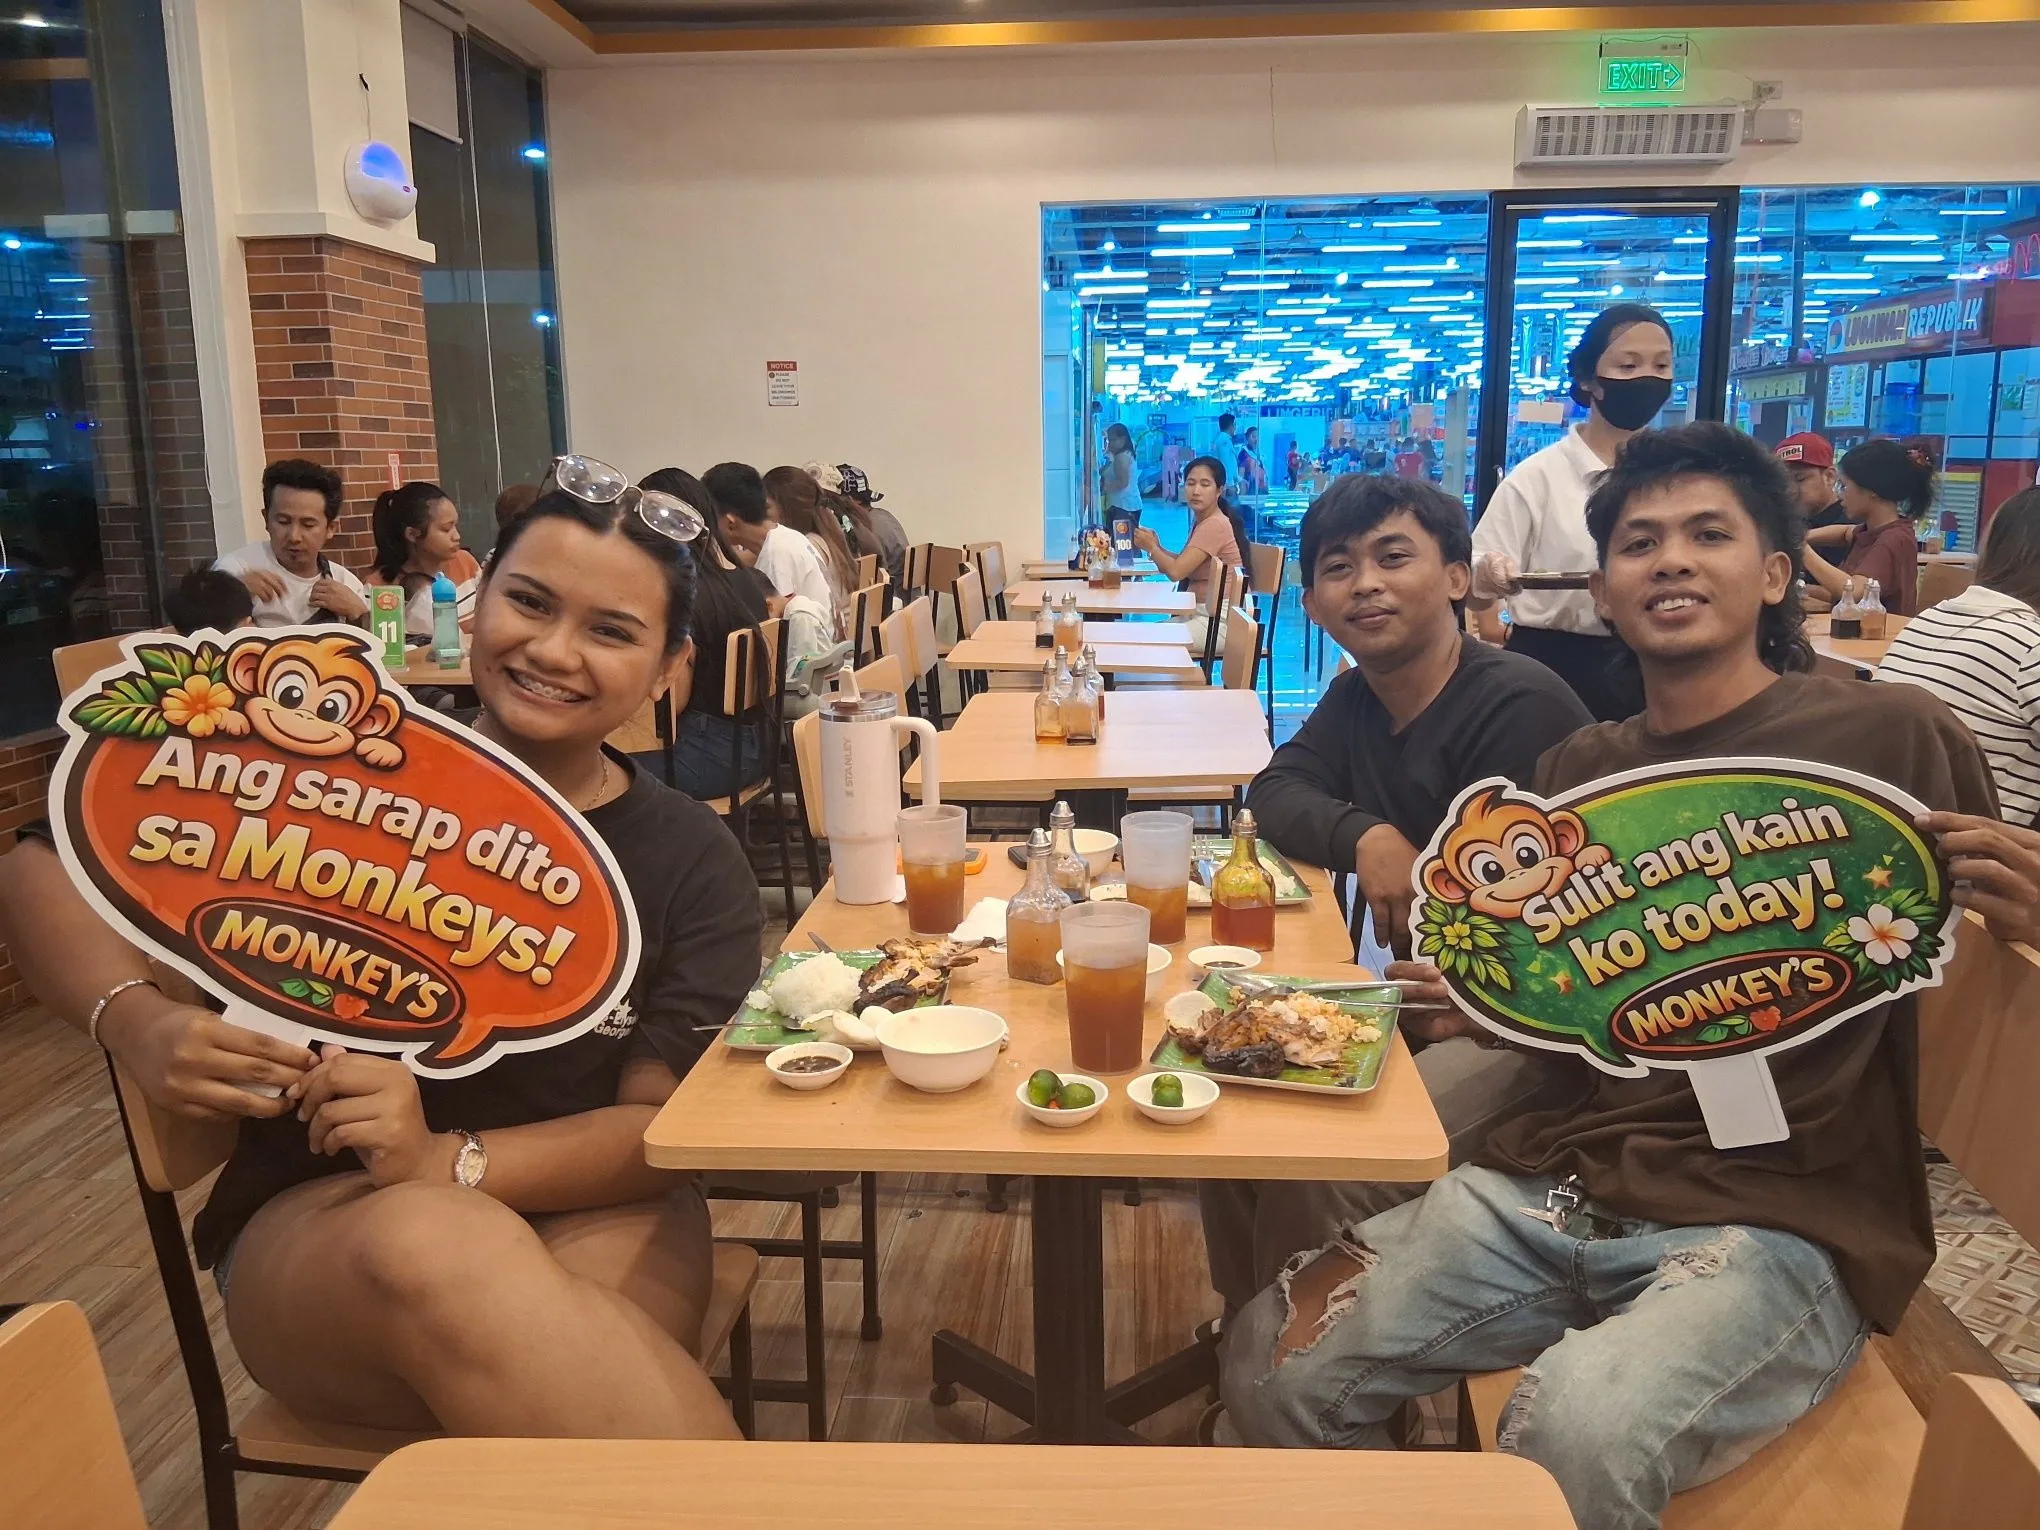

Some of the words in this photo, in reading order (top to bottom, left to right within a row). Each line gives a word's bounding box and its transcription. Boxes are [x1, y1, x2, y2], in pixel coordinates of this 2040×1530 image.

[1608, 63, 1662, 89] EXIT
[1907, 297, 1982, 338] REPUBLIK
[1116, 539, 1132, 550] 100
[379, 621, 397, 643] 11
[843, 737, 853, 787] STANLEY
[136, 736, 286, 811] Ang
[287, 770, 461, 856] sarap
[466, 823, 581, 906] dito
[128, 814, 217, 869] sa
[218, 816, 576, 986] Monkeys!
[1522, 860, 1636, 944] Sulit
[1632, 828, 1731, 887] ang
[1722, 797, 1849, 855] kain
[211, 909, 449, 1018] MONKEY'S
[1567, 929, 1646, 986] ko
[1643, 858, 1845, 951] today!
[1626, 956, 1834, 1044] MONKEY'S
